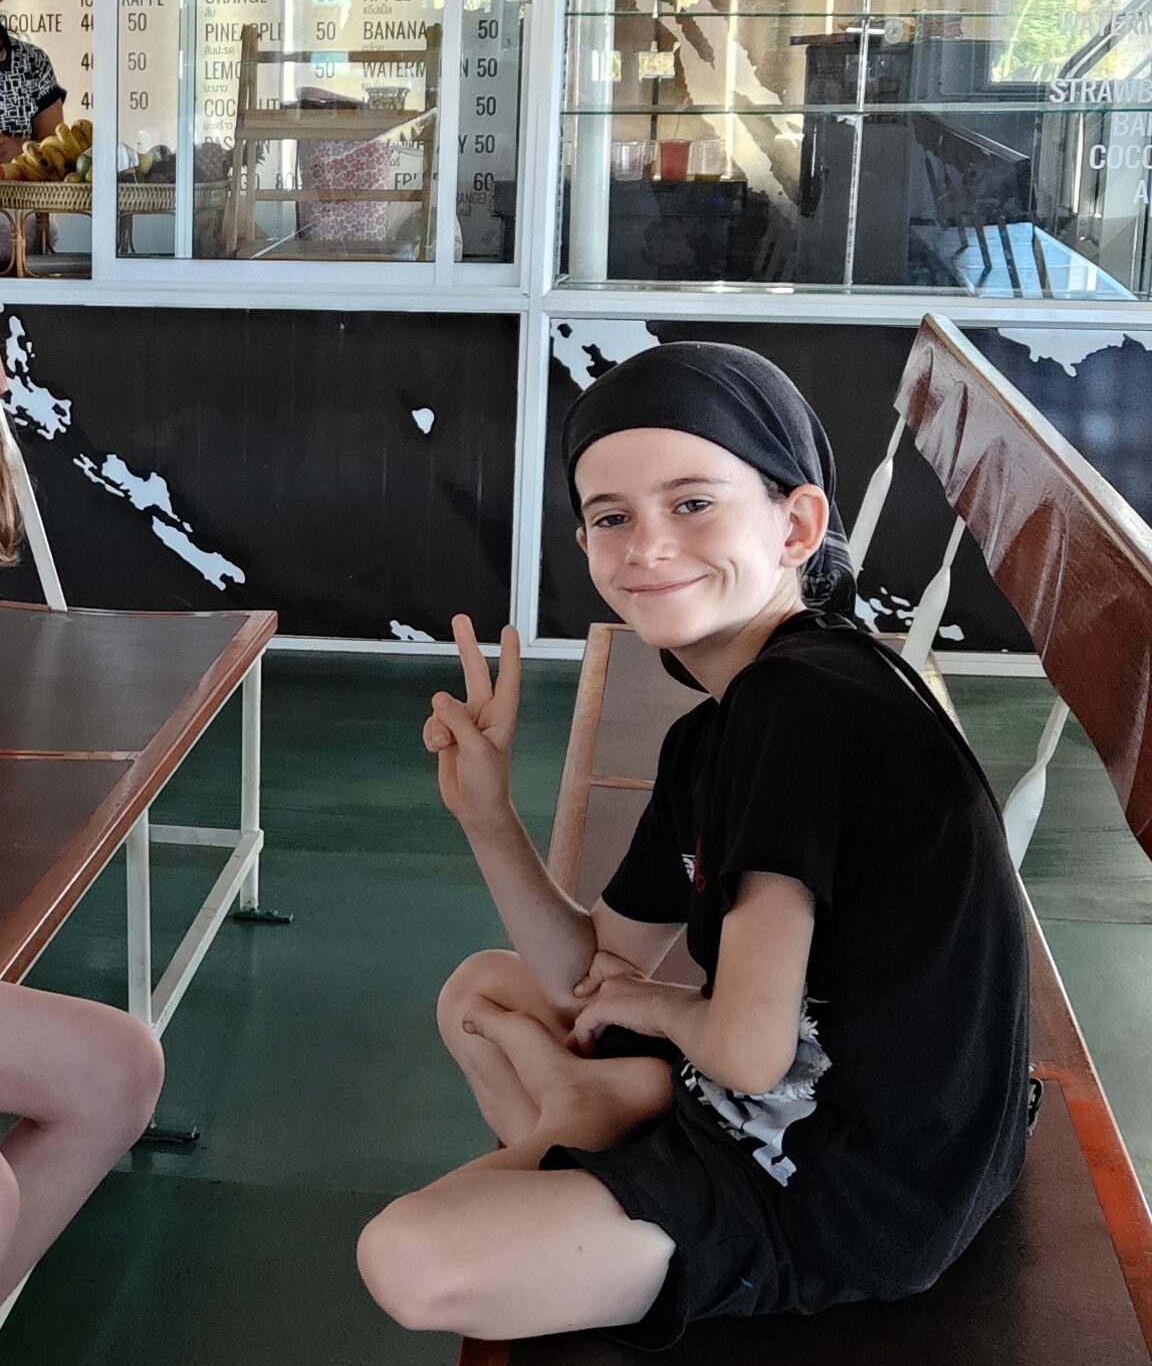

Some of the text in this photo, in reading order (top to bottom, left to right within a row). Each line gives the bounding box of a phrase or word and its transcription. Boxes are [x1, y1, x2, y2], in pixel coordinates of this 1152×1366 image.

[0, 12, 147, 33] OCOLATE 4 50
[316, 21, 336, 41] 50
[363, 19, 499, 40] BANANA 50
[80, 51, 147, 71] 4 50
[205, 60, 335, 80] LEMO 50
[362, 57, 498, 78] WATERMN 50
[80, 91, 149, 111] 4 50
[1049, 78, 1152, 104] STRAWB
[204, 98, 279, 117] COCUT
[475, 96, 497, 116] 50
[474, 134, 495, 154] 50
[1090, 144, 1152, 170] COCO
[473, 172, 495, 192] 60
